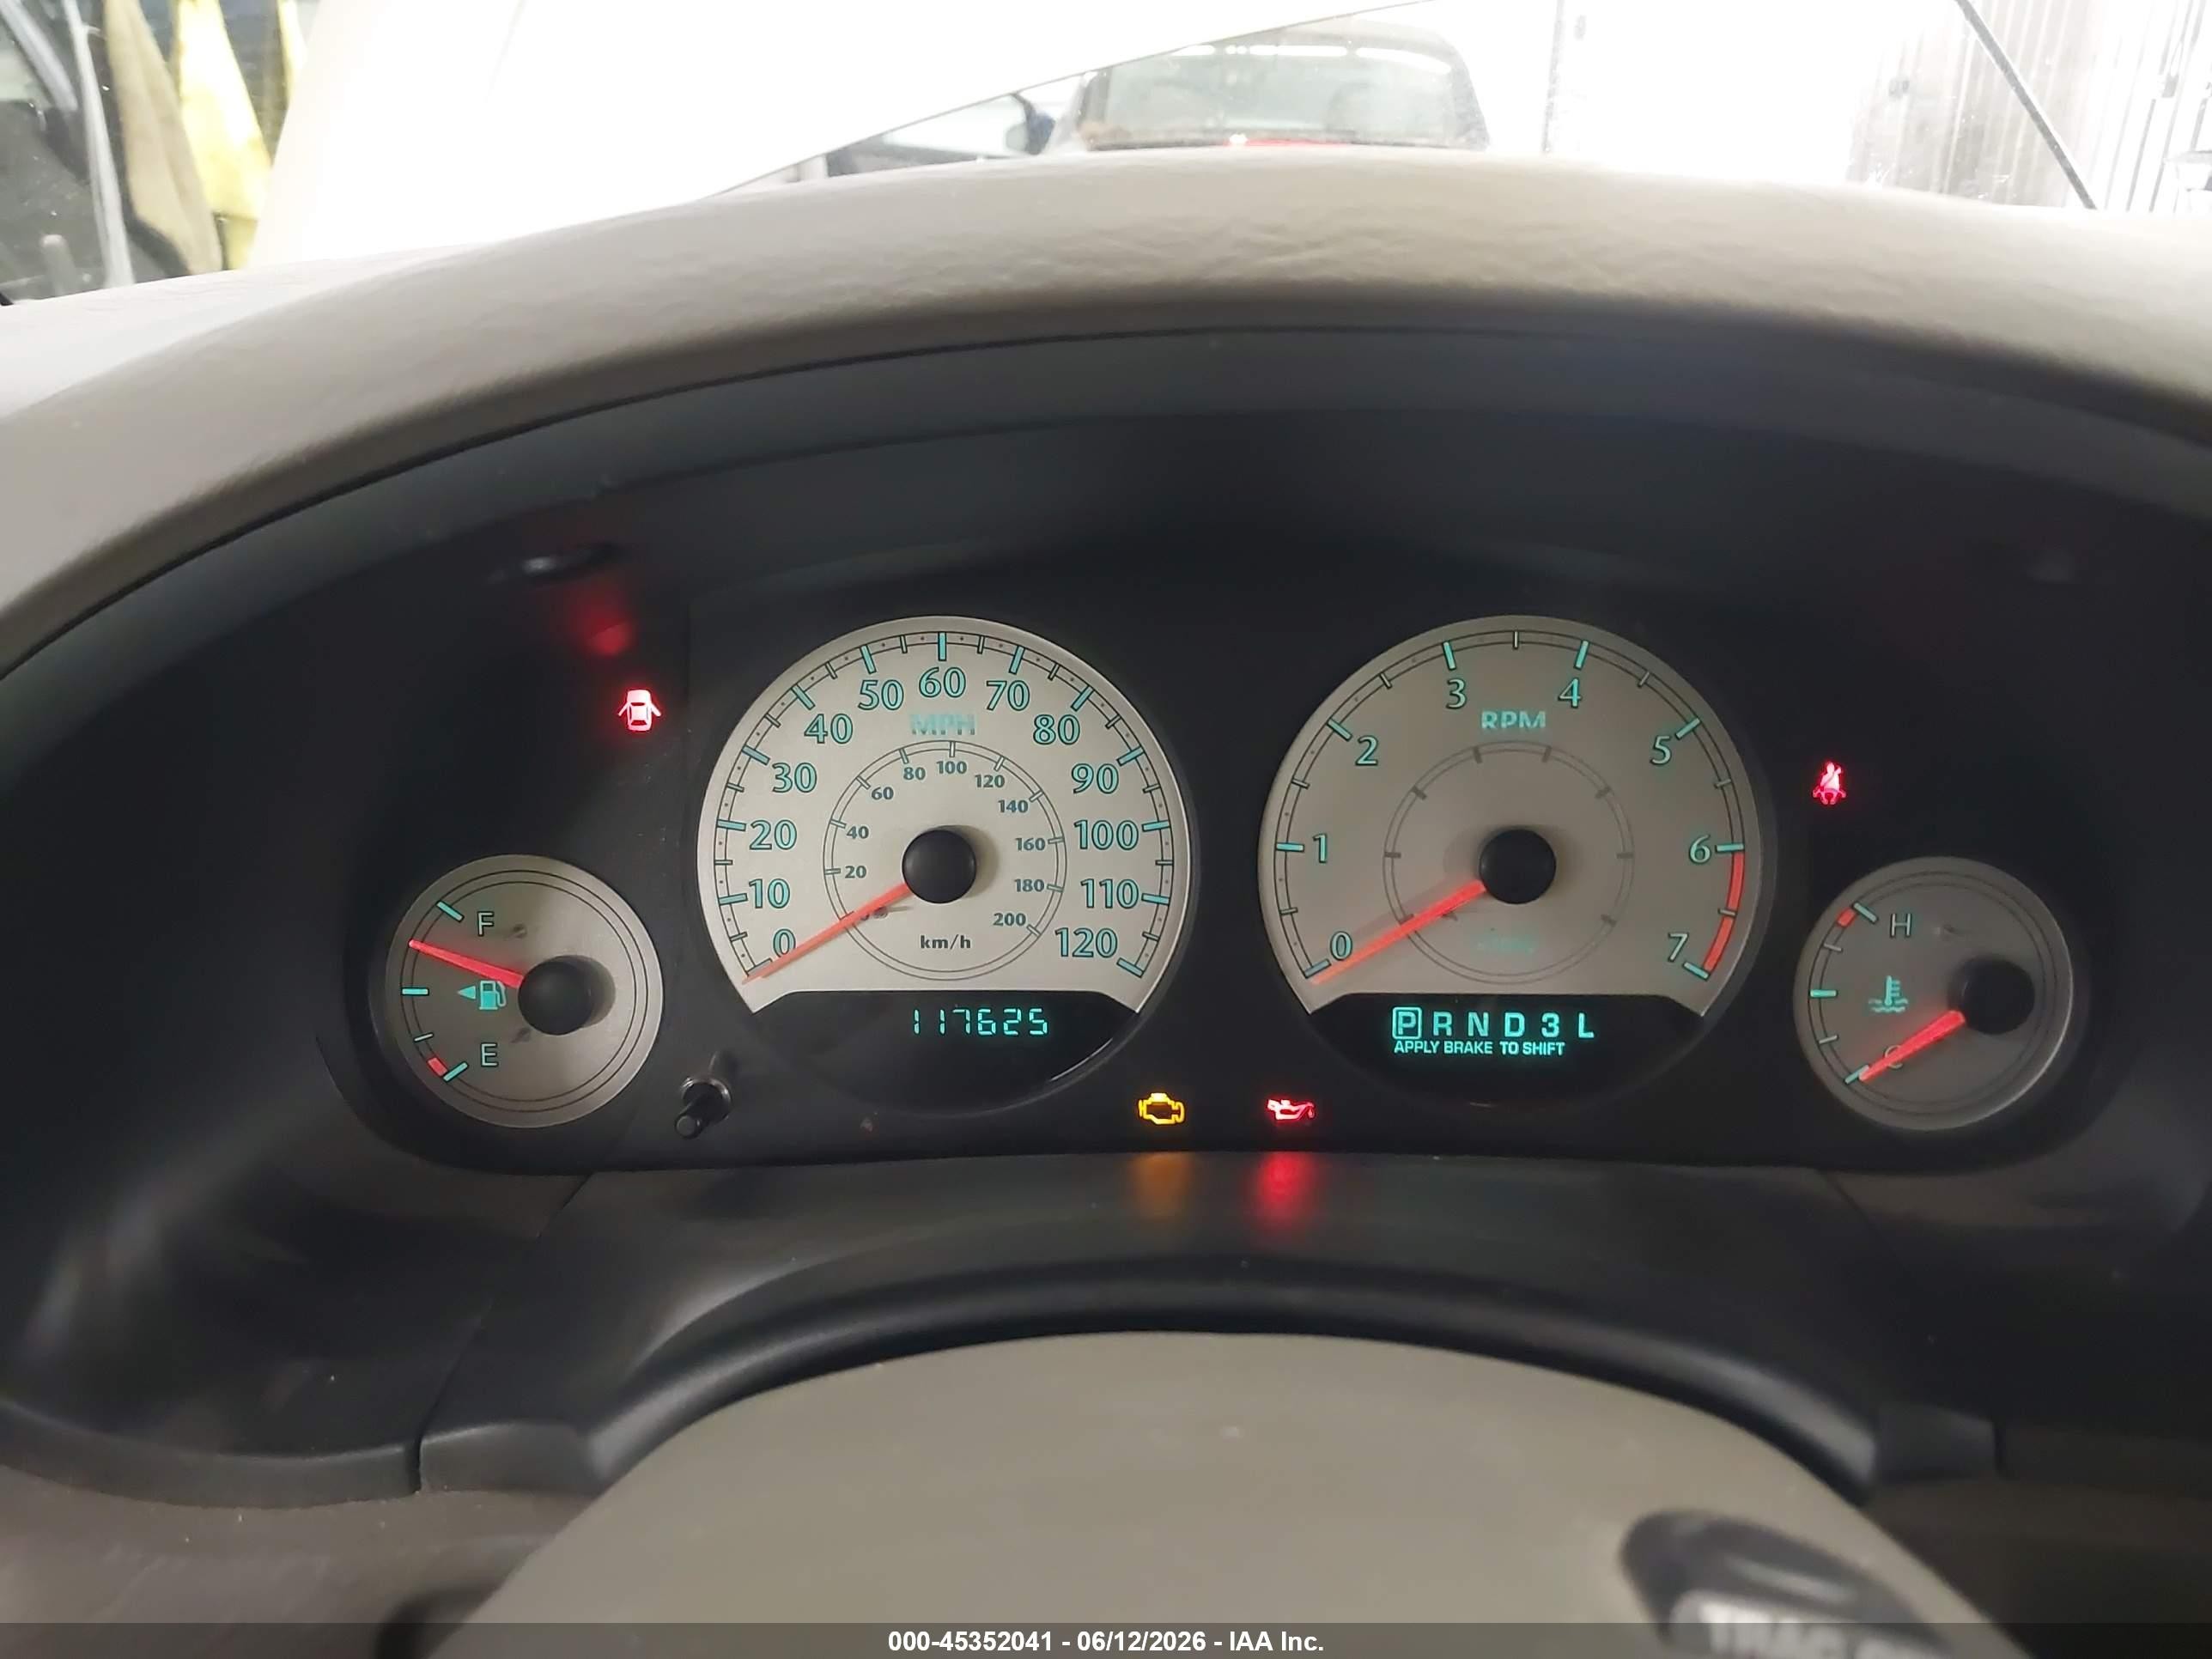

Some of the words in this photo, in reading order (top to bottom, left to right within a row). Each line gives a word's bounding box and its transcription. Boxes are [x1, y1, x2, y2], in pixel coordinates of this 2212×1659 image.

[858, 680, 904, 711] 50
[919, 667, 966, 697] 60
[986, 680, 1030, 711] 70
[1446, 678, 1468, 709] 3
[1558, 678, 1582, 708] 4
[804, 714, 854, 744] 40
[910, 714, 975, 735] MPH
[1033, 714, 1080, 745] 80
[1481, 710, 1546, 730] RPM
[1355, 737, 1379, 766] 2
[1650, 736, 1672, 765] 5
[773, 763, 817, 793] 30
[903, 767, 926, 781] 80
[936, 761, 967, 775] 100
[975, 775, 1005, 788] 120
[1072, 763, 1118, 793] 90
[871, 787, 894, 800] 60
[998, 799, 1028, 814] 140
[749, 819, 797, 850] 20
[847, 826, 869, 840] 40
[1015, 837, 1046, 851] 160
[1073, 821, 1139, 850] 100
[1313, 833, 1328, 863] 1
[1689, 835, 1711, 864] 6
[845, 865, 866, 879] 20
[1015, 878, 1044, 893] 180
[747, 878, 790, 908] 10
[1080, 878, 1139, 908] 110
[477, 912, 494, 936] F
[993, 912, 1025, 927] 200
[1890, 913, 1911, 937] H
[773, 928, 797, 958] 0
[920, 934, 972, 950] km/h
[1054, 927, 1118, 958] 120
[1329, 931, 1352, 960] 0
[1668, 933, 1688, 962] 7
[912, 1008, 1048, 1036] 117625
[1397, 1013, 1417, 1036] P
[1432, 1012, 1452, 1036] R
[1468, 1012, 1489, 1037] N
[1504, 1013, 1525, 1037] D
[1540, 1012, 1559, 1037] 3
[1578, 1012, 1594, 1038] L
[481, 1043, 498, 1067] E
[1394, 1041, 1439, 1054] APPLY
[1444, 1041, 1492, 1054] BRAKE
[1499, 1041, 1518, 1054] TO
[1522, 1042, 1565, 1056] SHIFT
